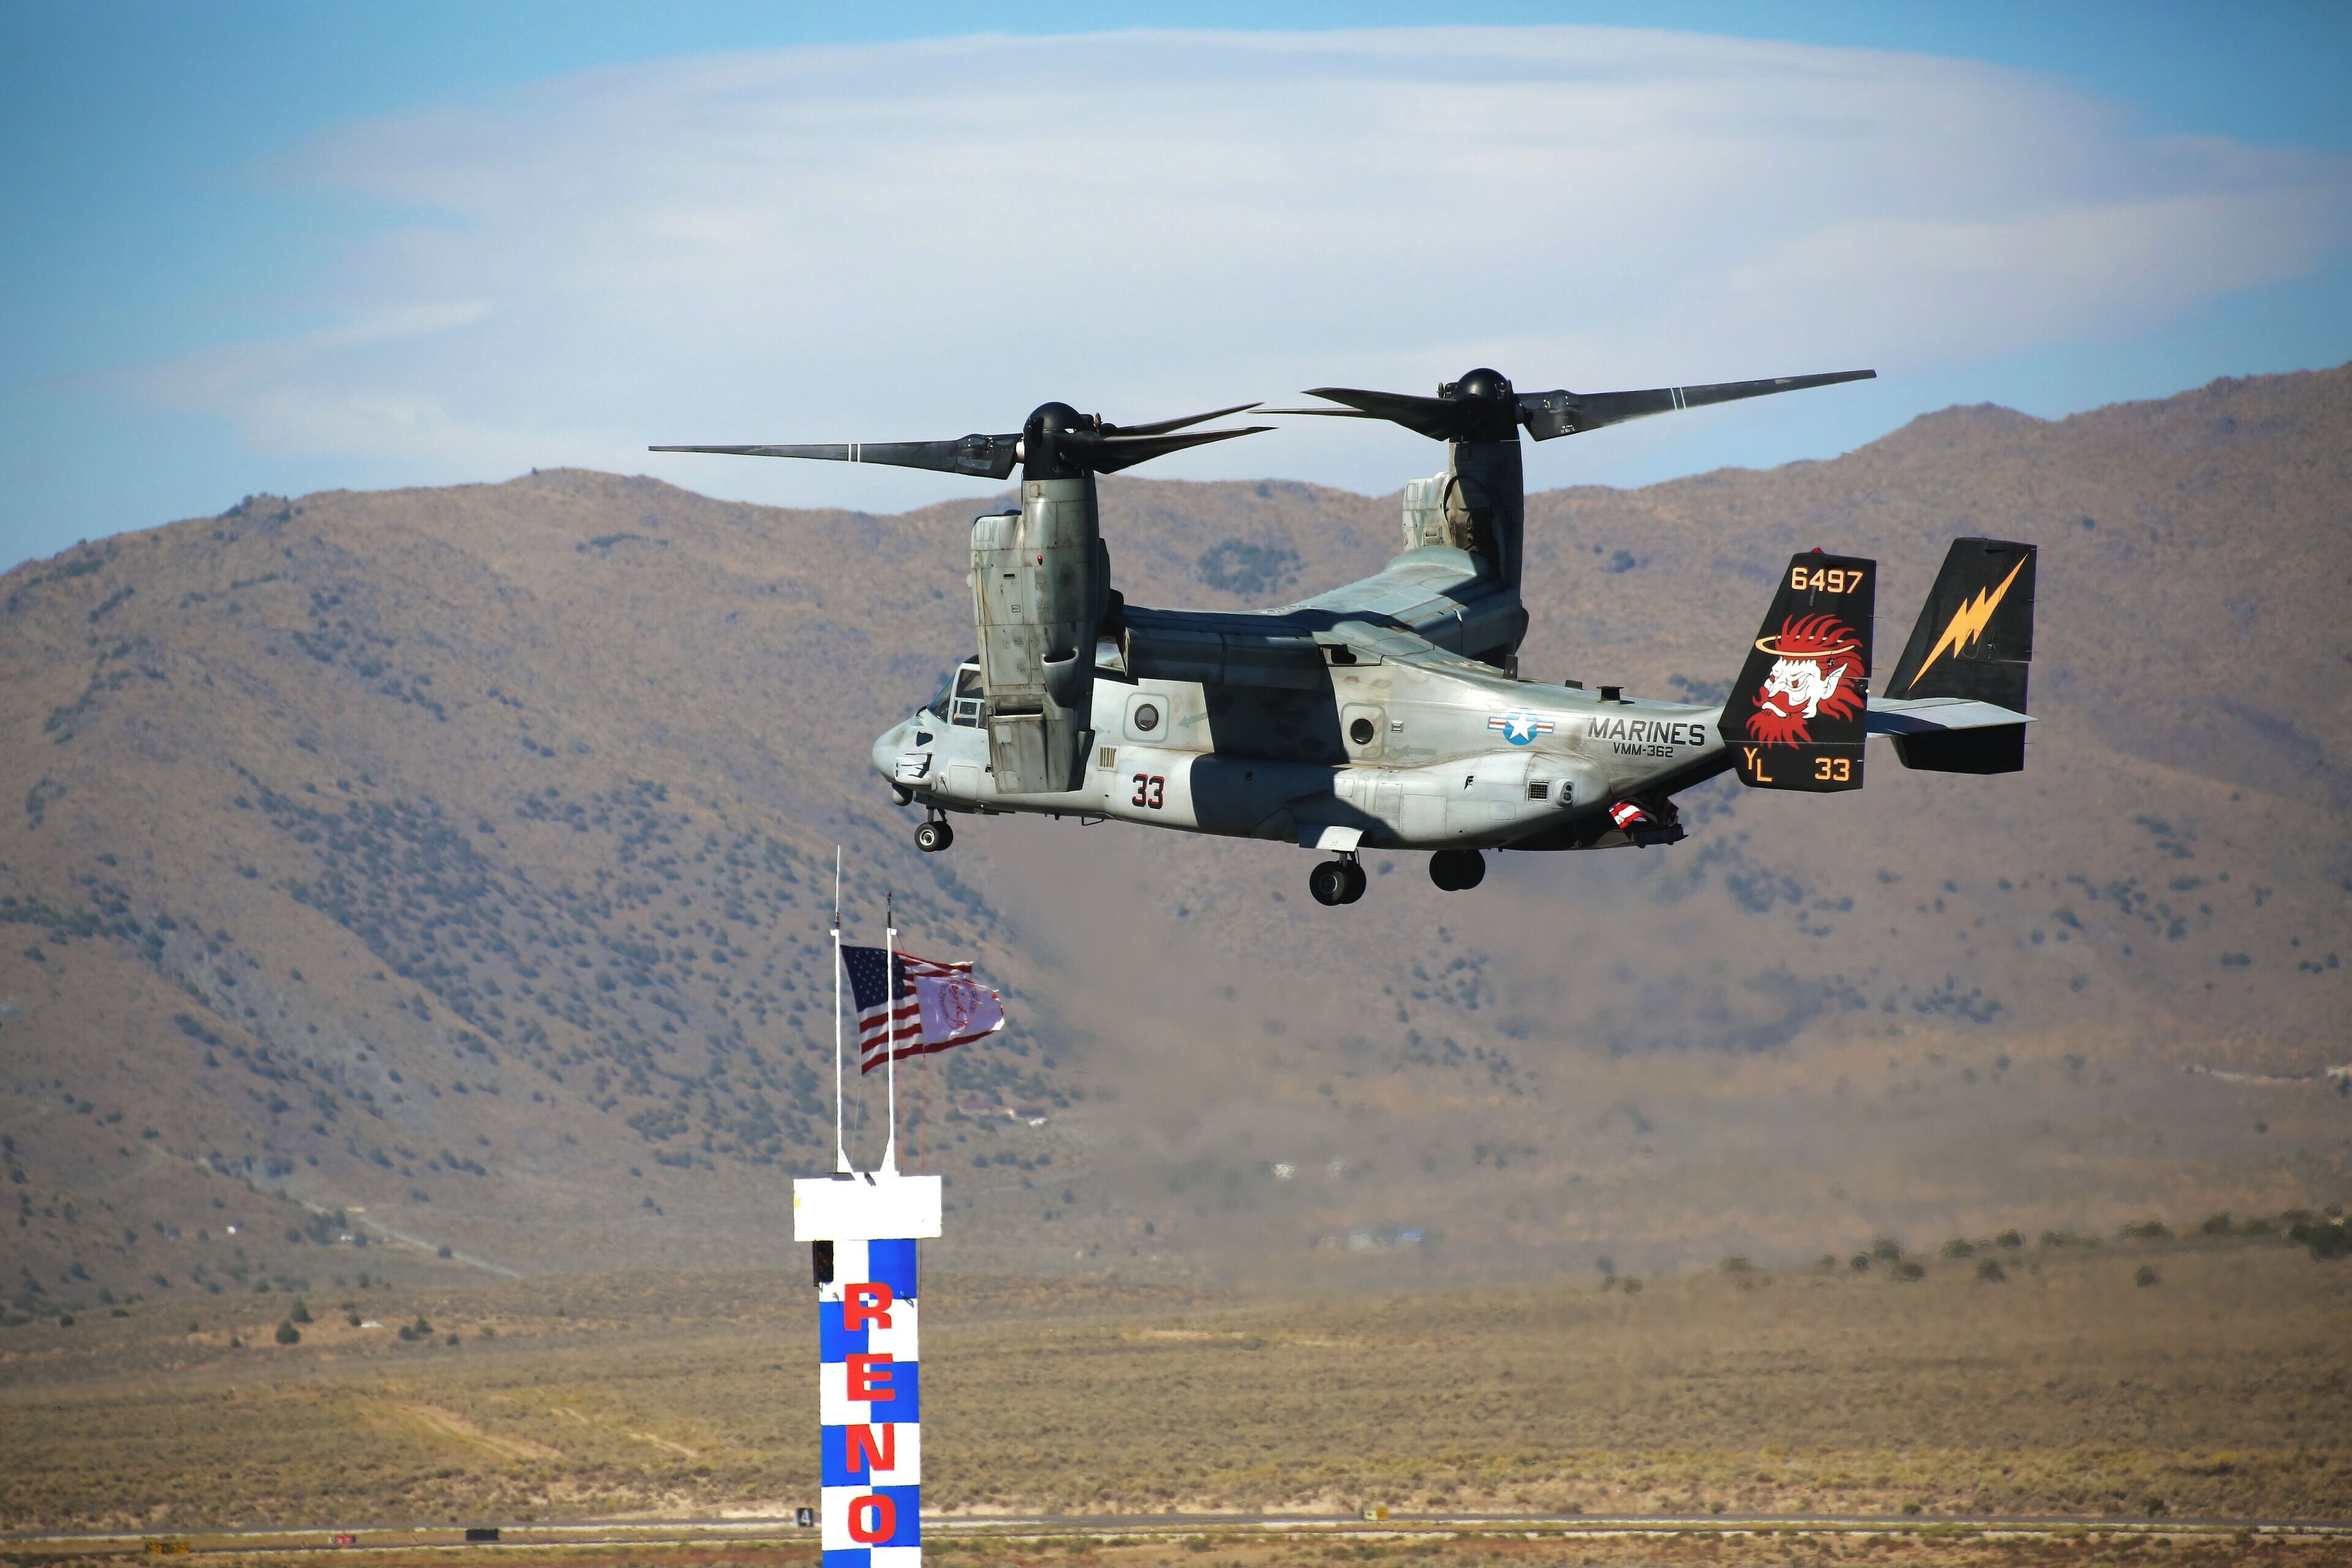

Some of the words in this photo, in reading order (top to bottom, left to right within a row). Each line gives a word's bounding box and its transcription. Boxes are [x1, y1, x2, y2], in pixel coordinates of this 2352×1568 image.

[1792, 567, 1863, 594] 6497
[1588, 717, 1705, 747] MARINES
[1613, 742, 1673, 758] VMM-362
[1815, 758, 1850, 782] 33
[1132, 774, 1165, 809] 33
[843, 1282, 896, 1544] RENO
[801, 1509, 811, 1525] 4
